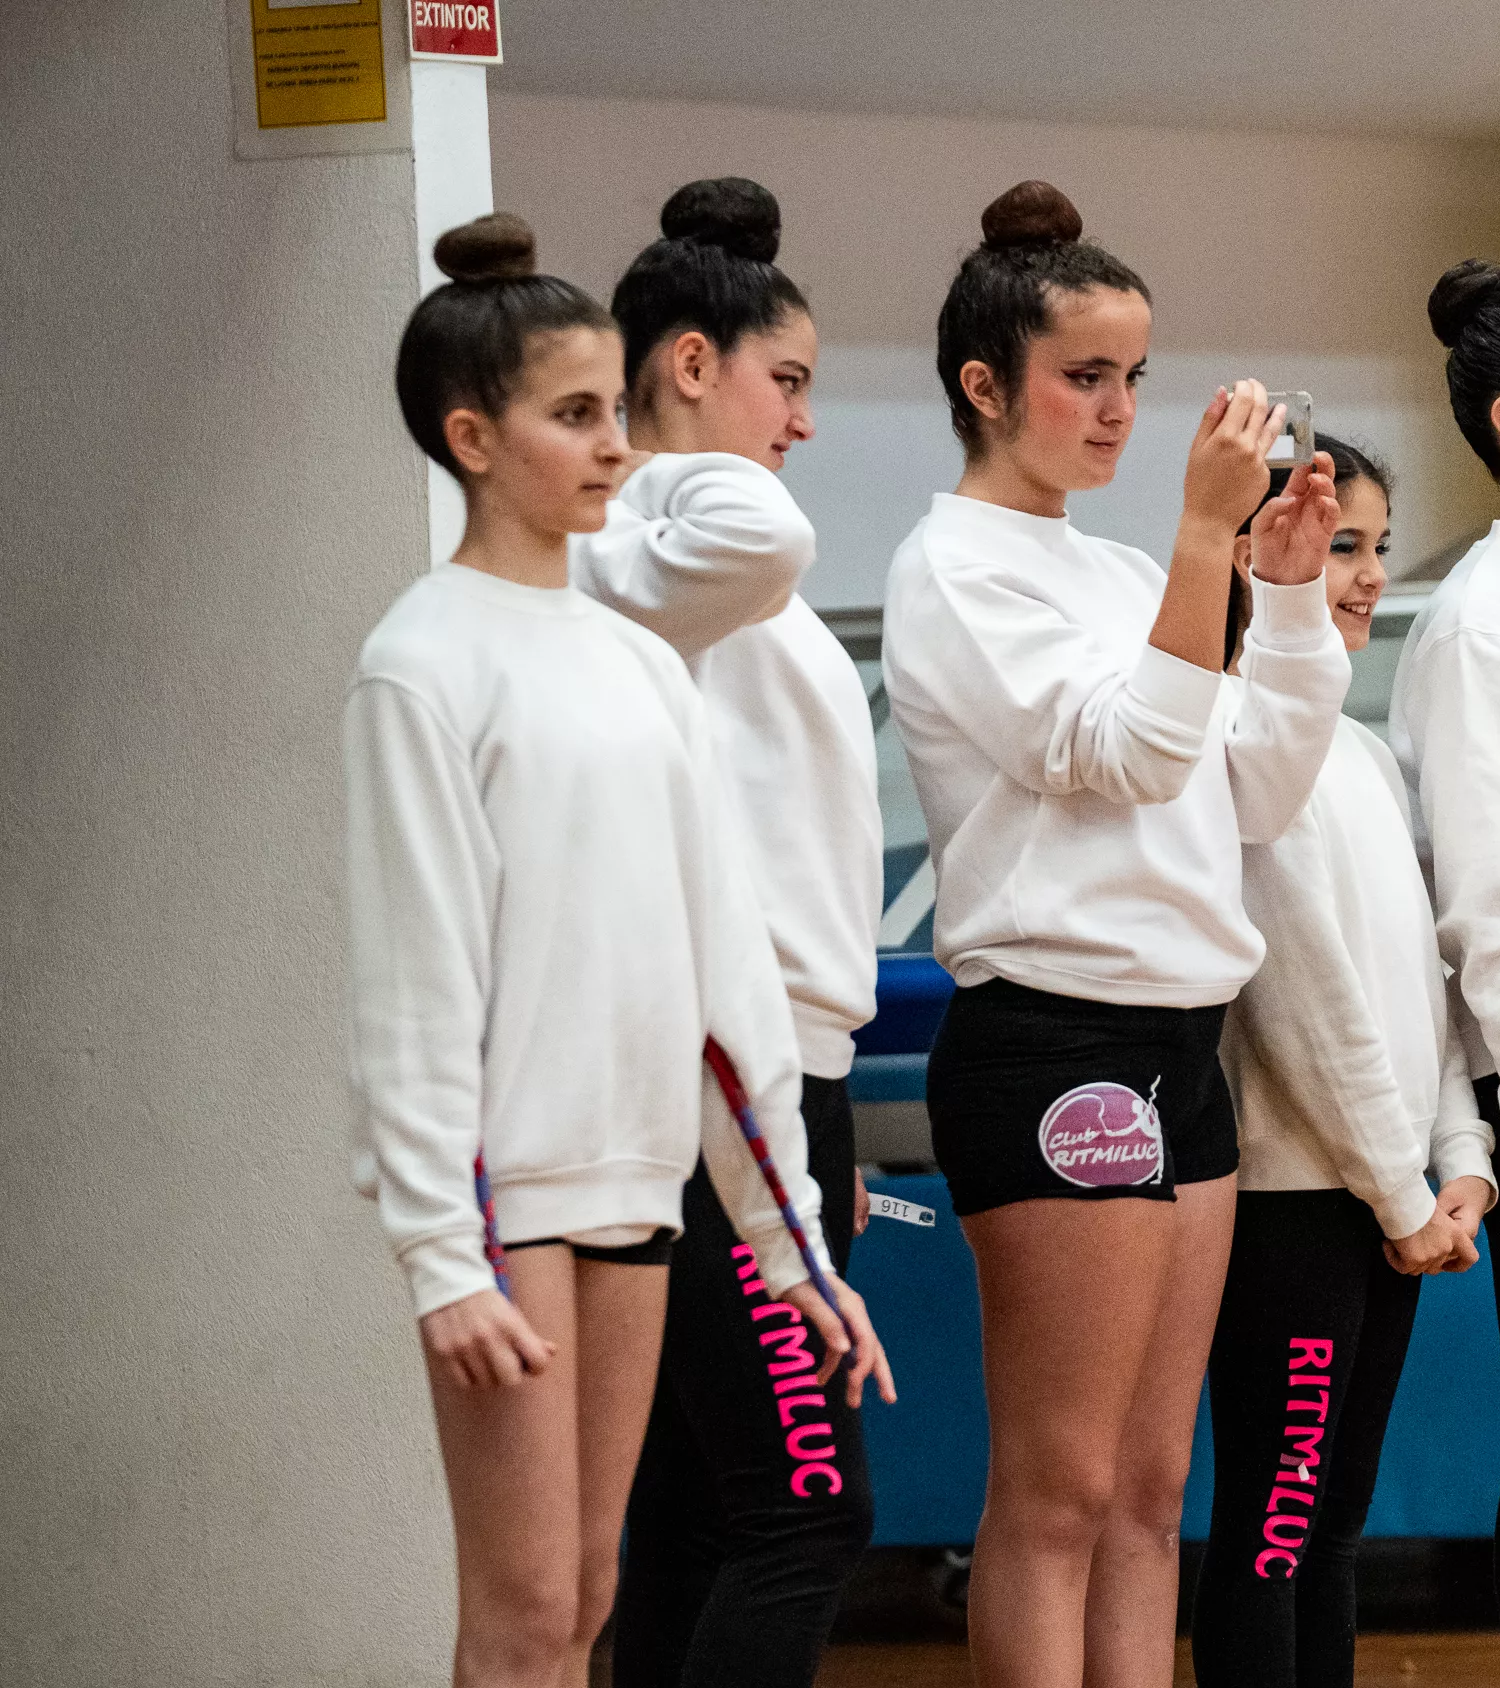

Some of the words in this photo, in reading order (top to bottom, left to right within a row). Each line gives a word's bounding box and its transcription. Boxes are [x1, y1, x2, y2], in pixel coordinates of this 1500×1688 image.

[415, 1, 490, 31] EXTINTOR
[1049, 1127, 1100, 1149] Club
[1053, 1142, 1159, 1167] RITMILUC
[881, 1199, 910, 1217] 116
[1254, 1337, 1334, 1579] RITMILUC
